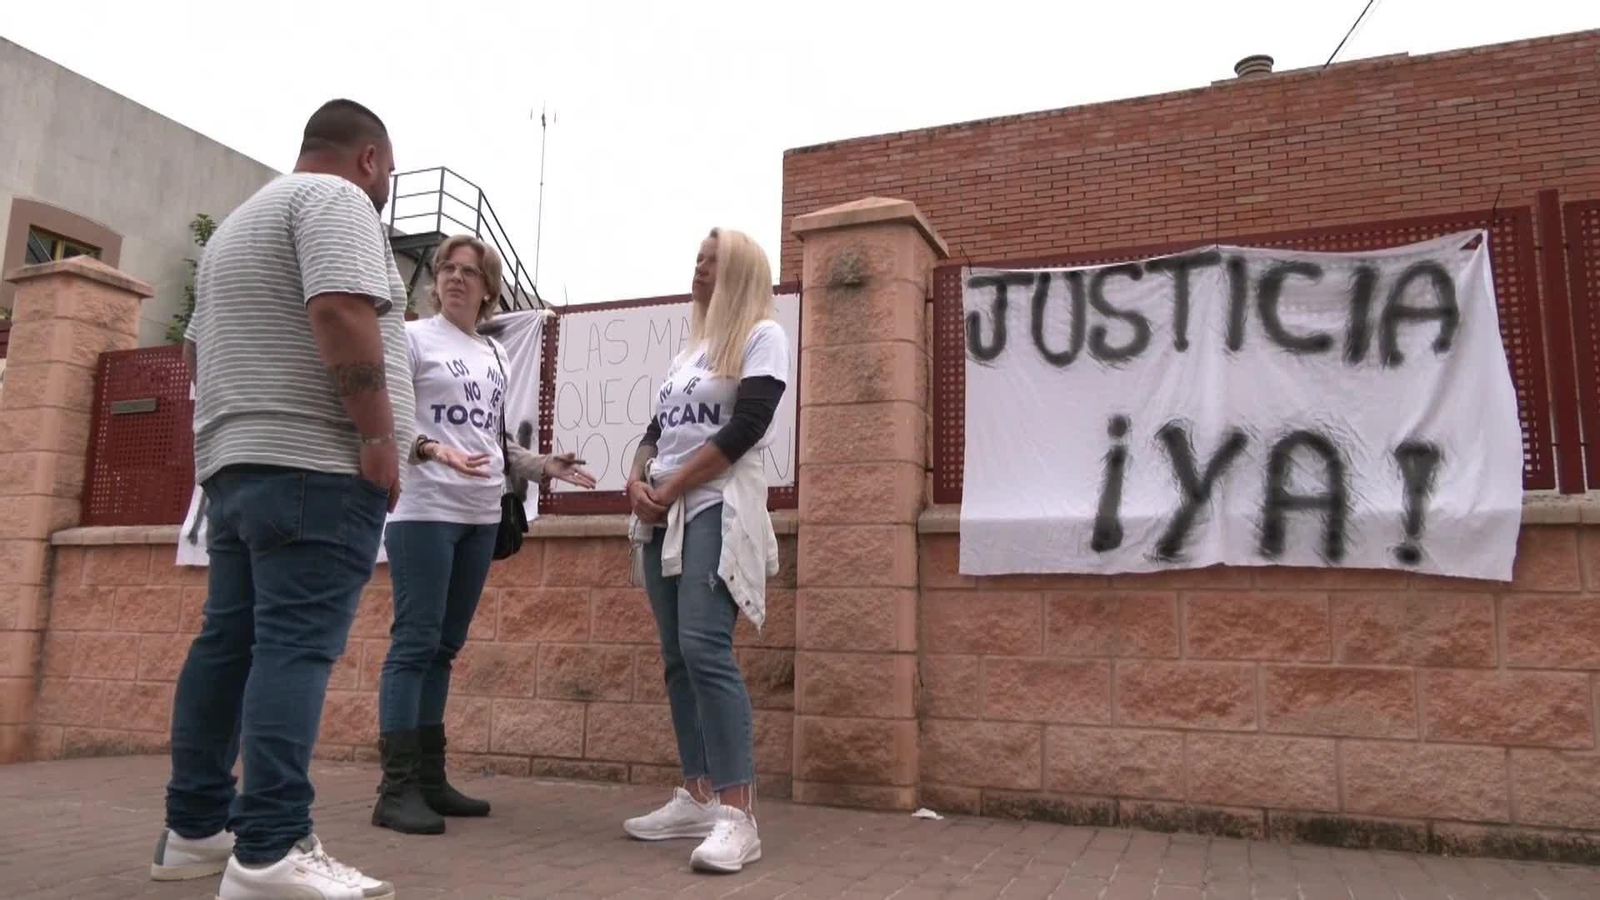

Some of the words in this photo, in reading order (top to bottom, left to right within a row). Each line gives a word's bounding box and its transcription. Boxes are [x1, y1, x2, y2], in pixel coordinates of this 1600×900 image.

[967, 251, 1461, 367] JUSTICIA
[563, 319, 628, 372] LAS
[446, 359, 470, 378] LOS
[464, 381, 481, 402] NO
[660, 381, 673, 404] NO
[431, 404, 497, 434] TOCA
[659, 402, 721, 430] OCAN
